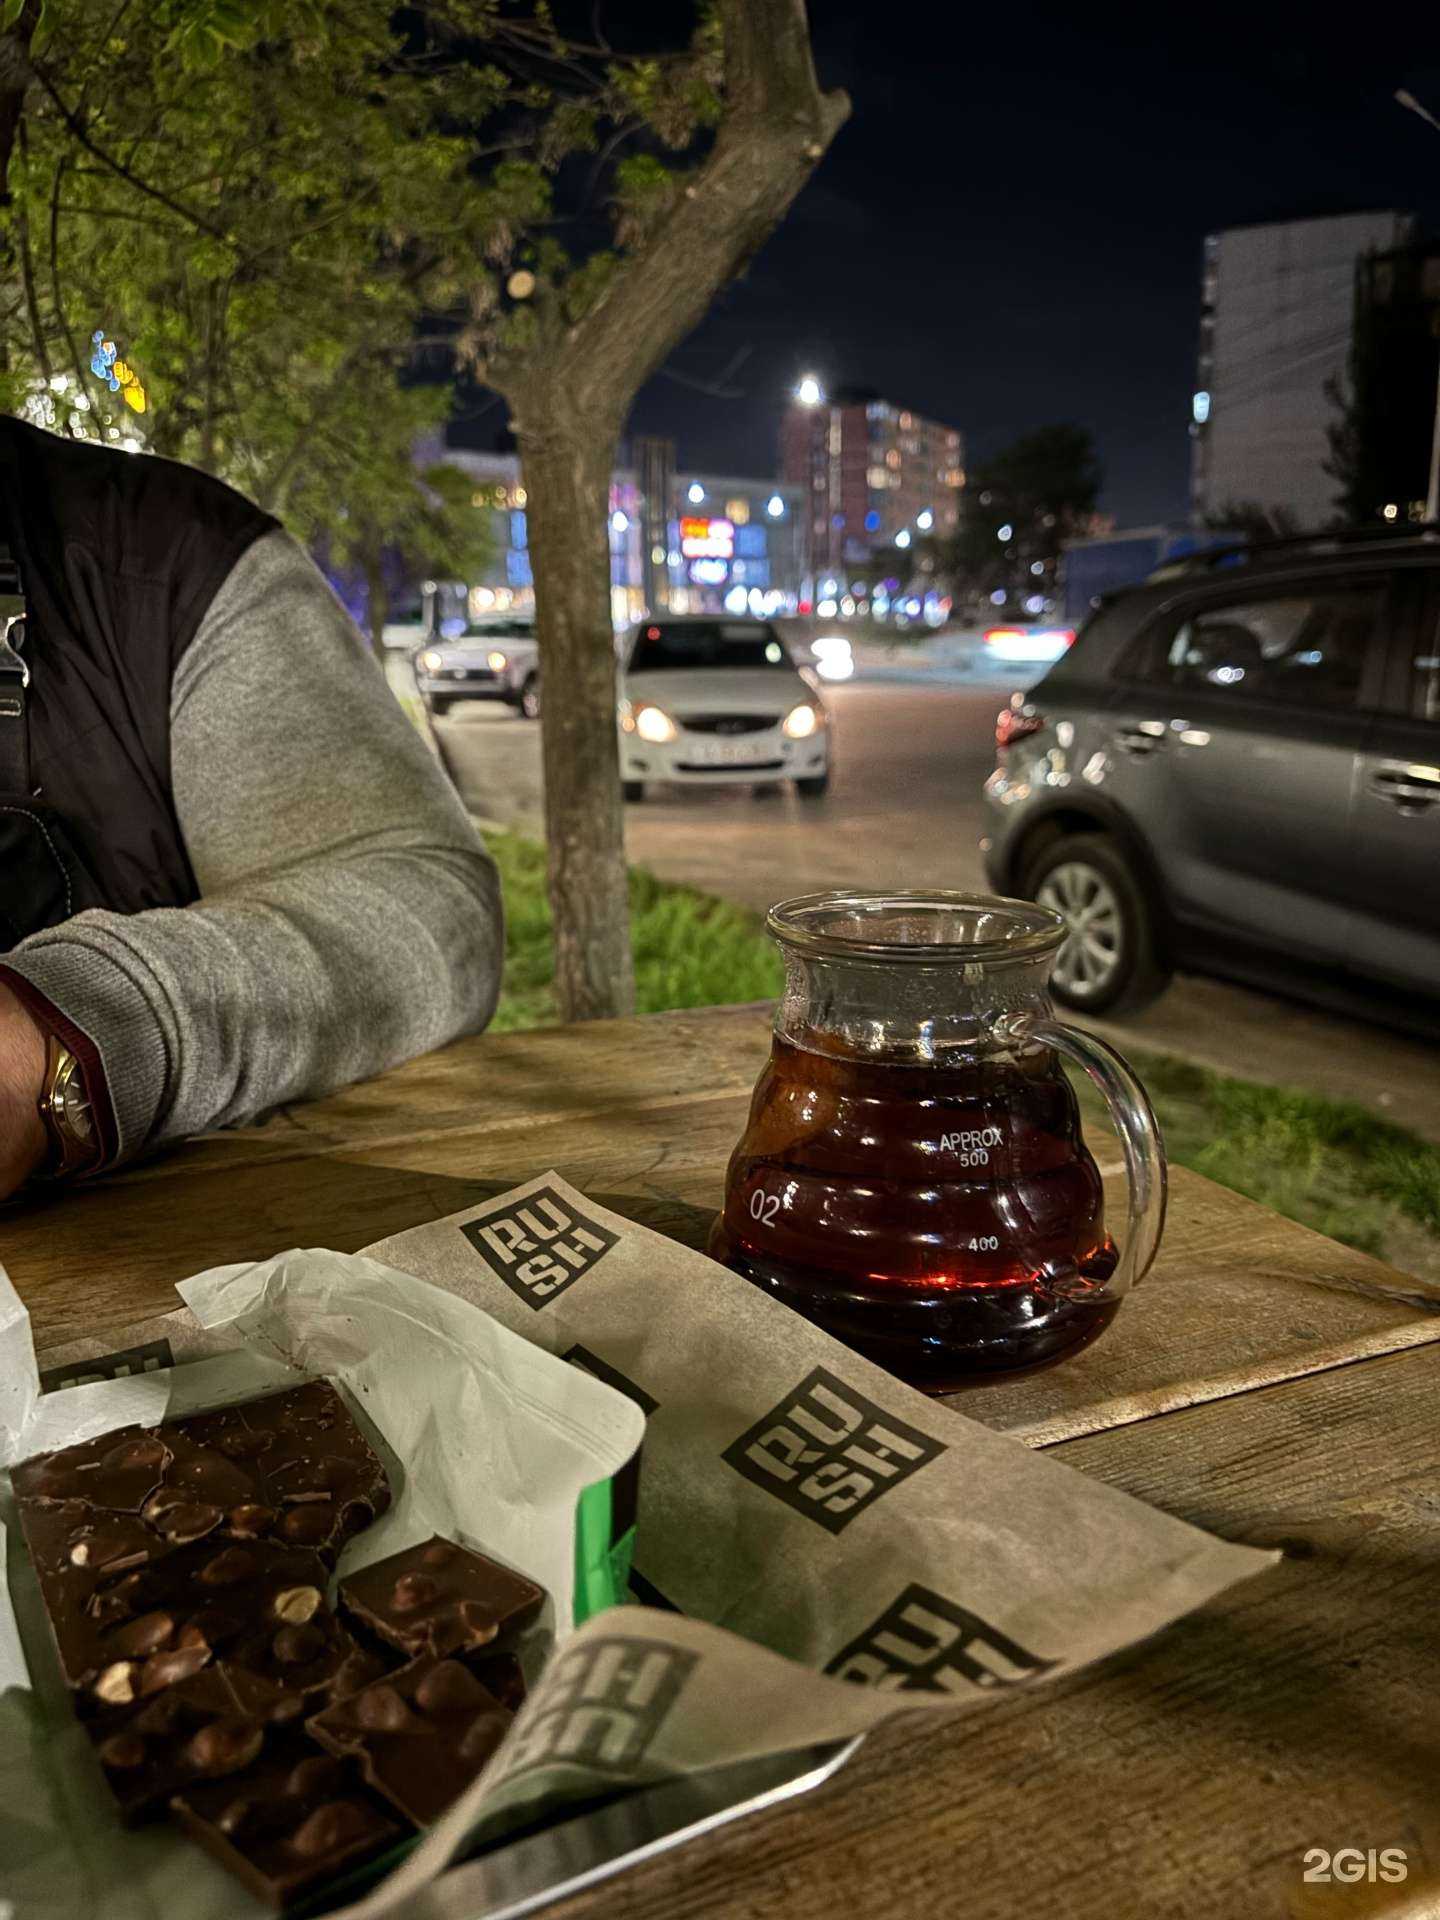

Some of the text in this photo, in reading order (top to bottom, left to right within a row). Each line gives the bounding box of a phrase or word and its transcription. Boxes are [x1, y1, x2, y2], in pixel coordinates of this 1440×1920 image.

[940, 1127, 1003, 1151] APPROX
[960, 1150, 989, 1167] 500
[750, 1188, 780, 1228] 02
[968, 1235, 999, 1251] 400
